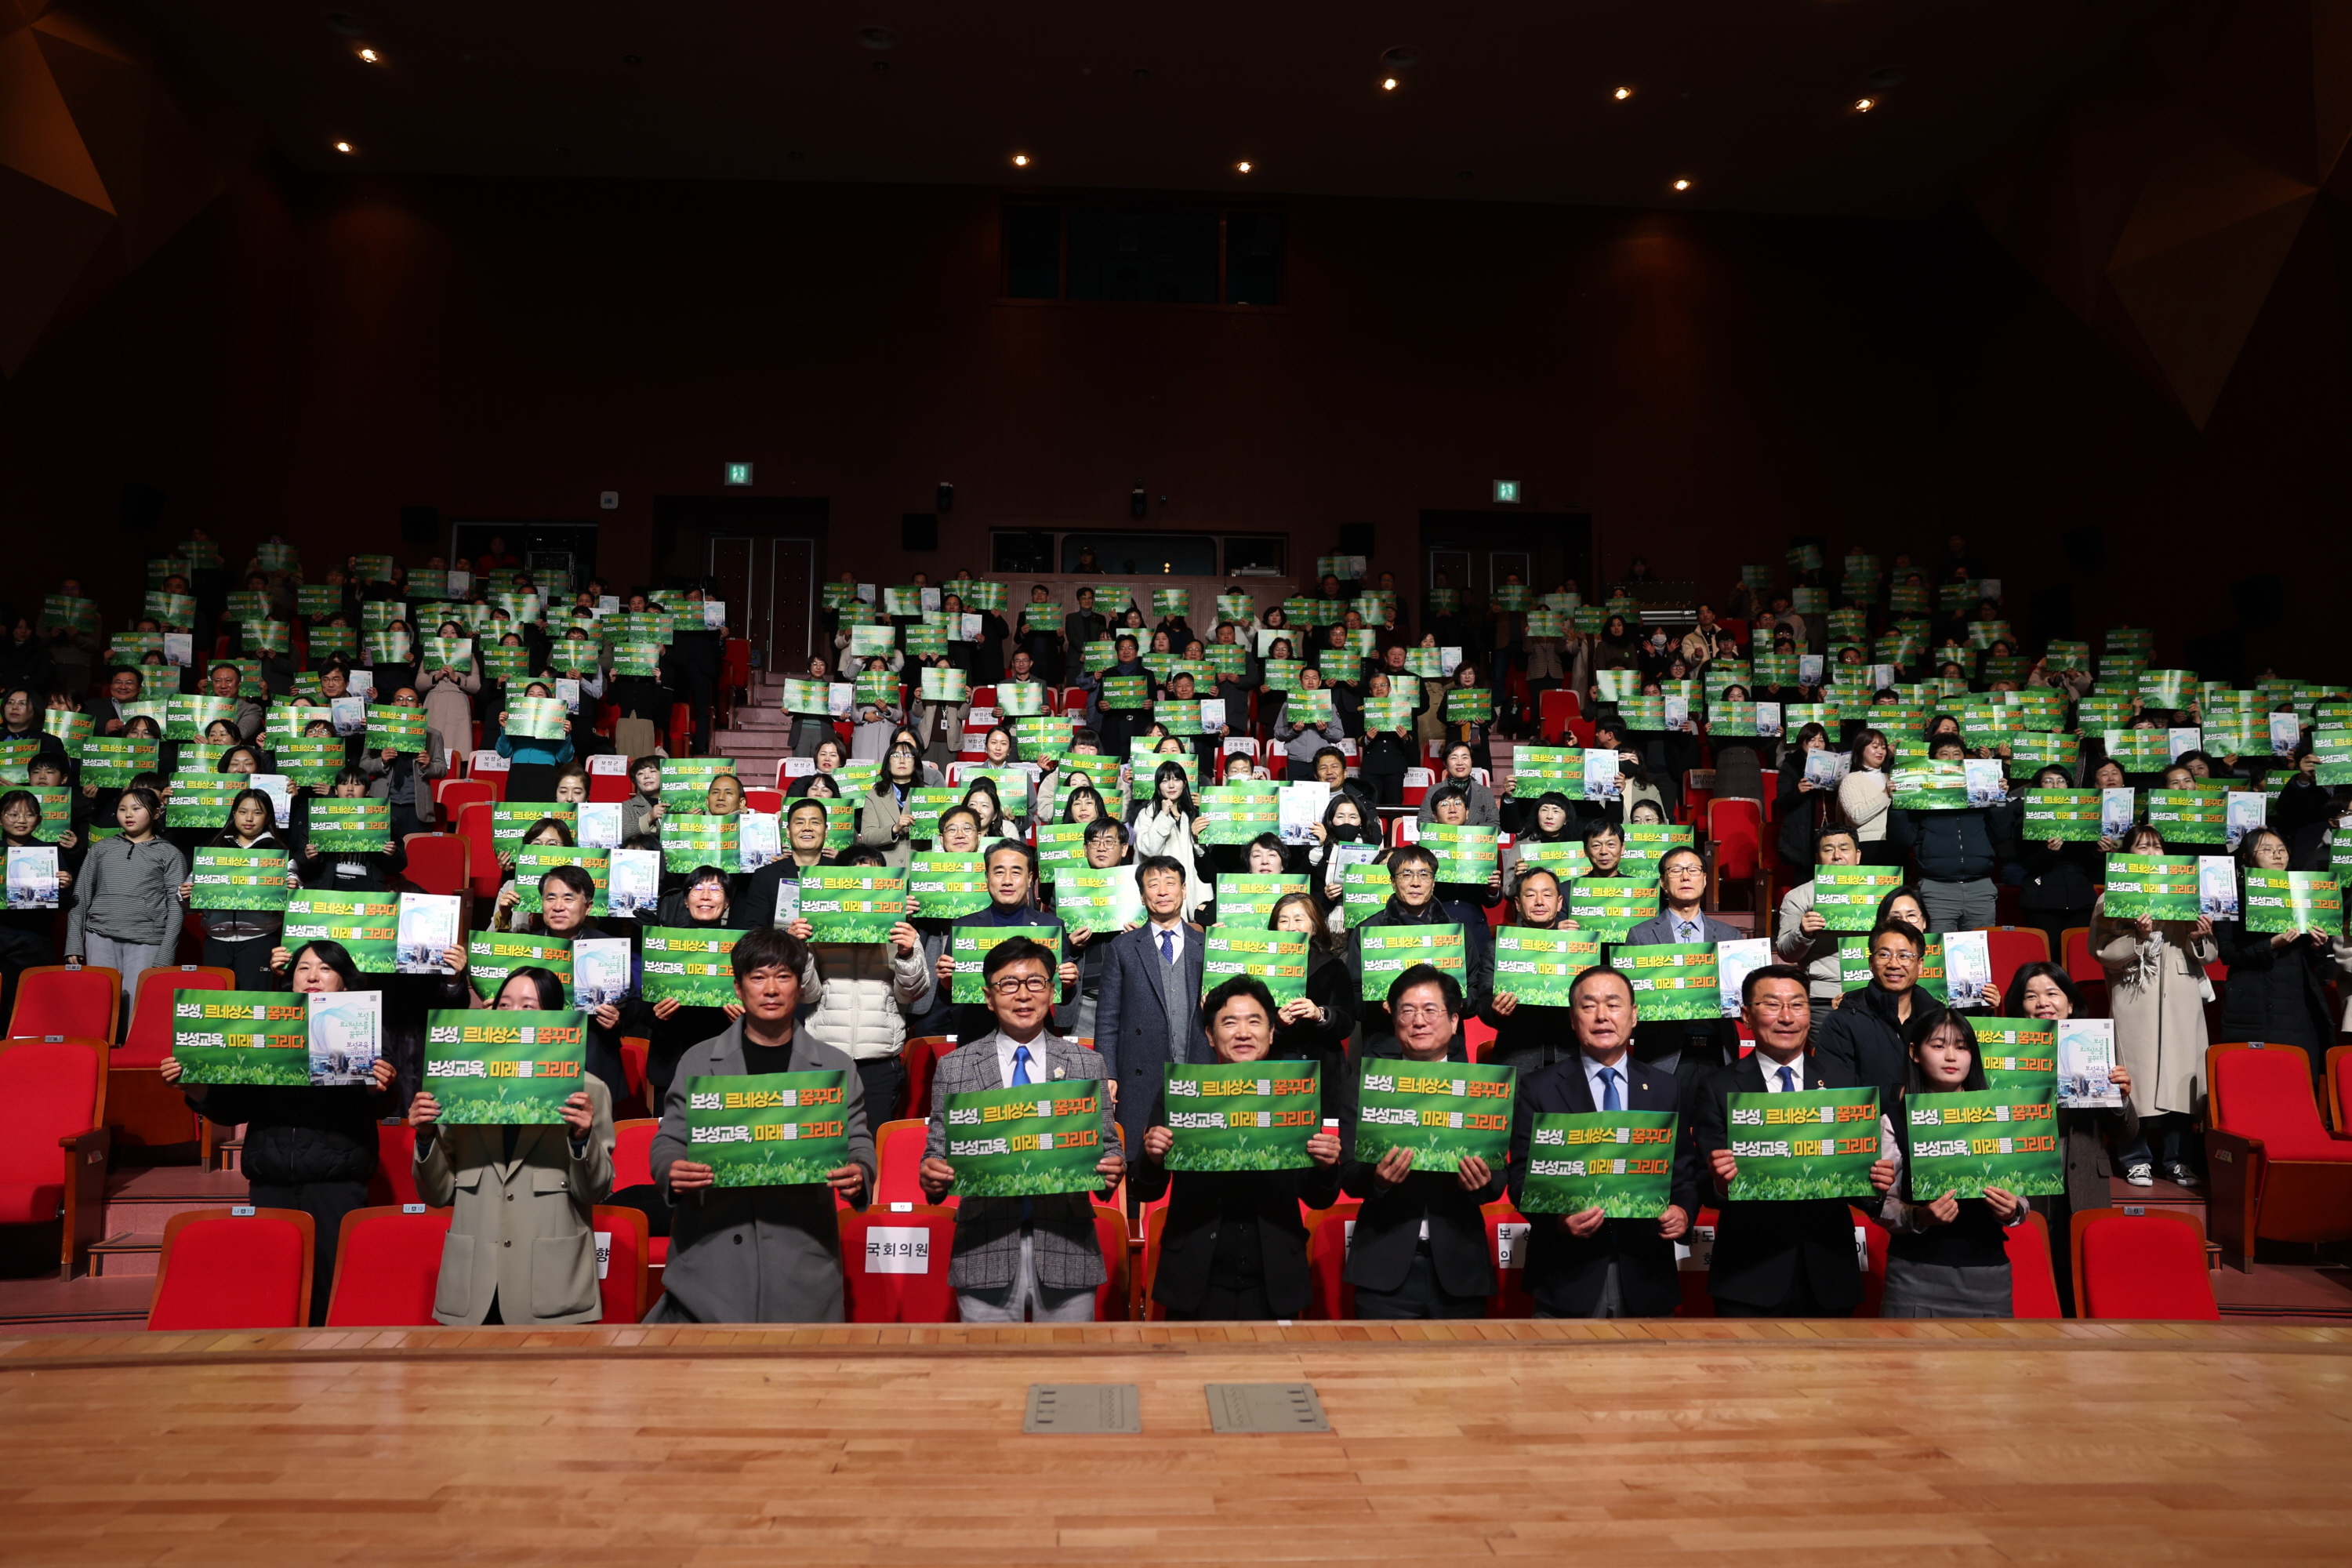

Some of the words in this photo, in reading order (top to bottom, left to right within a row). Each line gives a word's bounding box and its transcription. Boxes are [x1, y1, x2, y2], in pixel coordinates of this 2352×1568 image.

[100, 745, 135, 753] 르네상스를
[82, 759, 112, 768] 보성교육,
[2026, 796, 2043, 804] 보성,
[2043, 796, 2078, 804] 르네상스를
[310, 806, 328, 815] 보성,
[328, 806, 366, 815] 르네상스를
[2025, 811, 2056, 820] 보성교육,
[310, 822, 343, 830] 보성교육,
[343, 822, 365, 830] 미래를
[195, 856, 216, 866] 보성,
[216, 857, 261, 867] 르네상스를
[260, 858, 285, 867] 꿈꾸다
[2108, 862, 2128, 873] 보성,
[2128, 863, 2169, 875] 르네상스를
[2169, 865, 2197, 875] 꿈꾸다
[193, 875, 231, 885] 보성교육,
[232, 876, 258, 885] 미래를
[259, 877, 286, 886] 그리다
[801, 877, 824, 890] 보성,
[824, 878, 874, 890] 르네상스를
[873, 878, 903, 890] 꿈꾸다
[2107, 882, 2143, 893] 보성교육,
[2143, 884, 2169, 894] 미래를
[2170, 884, 2198, 894] 그리다
[1572, 887, 1592, 898] 보성,
[1592, 887, 1633, 898] 르네상스를
[1633, 887, 1658, 898] 꿈꾸다
[288, 901, 313, 914] 보성,
[312, 902, 366, 916] 르네상스를
[365, 904, 397, 916] 꿈꾸다
[801, 900, 843, 913] 보성교육,
[843, 901, 872, 913] 미래를
[873, 902, 903, 913] 그리다
[1570, 906, 1606, 917] 보성교육,
[1607, 907, 1632, 917] 미래를
[1632, 908, 1657, 917] 그리다
[285, 925, 330, 938] 보성교육,
[331, 927, 363, 940] 미래를
[363, 928, 395, 940] 그리다
[176, 1004, 204, 1019] 보성,
[204, 1004, 266, 1020] 르네상스를
[267, 1006, 305, 1021] 꿈꾸다
[176, 1032, 227, 1047] 보성교육,
[228, 1033, 265, 1048] 미래를
[267, 1035, 305, 1048] 그리다
[430, 1026, 461, 1044] 보성,
[463, 1026, 535, 1044] 르네상스를
[537, 1027, 583, 1044] 꿈꾸다
[426, 1060, 488, 1078] 보성교육,
[489, 1061, 533, 1078] 미래를
[535, 1061, 580, 1078] 그리다
[1169, 1079, 1200, 1098] 보성,
[1202, 1079, 1271, 1096] 르네상스를
[1273, 1078, 1316, 1095] 꿈꾸다
[1363, 1074, 1396, 1093] 보성,
[1397, 1076, 1466, 1096] 르네상스를
[1468, 1080, 1511, 1098] 꿈꾸다
[691, 1093, 724, 1110] 보성,
[725, 1090, 797, 1109] 르네상스를
[799, 1087, 843, 1106] 꿈꾸다
[949, 1108, 982, 1124] 보성,
[983, 1100, 1051, 1123] 르네상스를
[1054, 1097, 1097, 1116] 꿈꾸다
[1361, 1107, 1420, 1127] 보성교육,
[1422, 1110, 1464, 1129] 미래를
[1465, 1113, 1508, 1131] 그리다
[1732, 1109, 1764, 1126] 보성,
[1766, 1106, 1834, 1124] 르네상스를
[1836, 1104, 1877, 1122] 꿈꾸다
[1911, 1109, 1942, 1125] 보성,
[1944, 1105, 2009, 1123] 르네상스를
[2012, 1104, 2053, 1121] 꿈꾸다
[1168, 1112, 1228, 1129] 보성교육,
[1229, 1111, 1271, 1127] 미래를
[1273, 1110, 1316, 1127] 그리다
[691, 1125, 753, 1143] 보성교육,
[754, 1123, 797, 1141] 미래를
[800, 1120, 844, 1139] 그리다
[1534, 1129, 1566, 1146] 보성,
[1566, 1127, 1630, 1145] 르네상스를
[1632, 1128, 1672, 1144] 꿈꾸다
[950, 1138, 1011, 1156] 보성교육,
[1011, 1133, 1053, 1152] 미래를
[1055, 1130, 1098, 1149] 그리다
[1730, 1141, 1792, 1157] 보성교육,
[1794, 1139, 1835, 1156] 미래를
[1837, 1137, 1878, 1154] 그리다
[1913, 1140, 1971, 1157] 보성교육,
[1973, 1138, 2013, 1155] 미래를
[2015, 1135, 2056, 1152] 그리다
[1530, 1160, 1587, 1176] 보성교육,
[1588, 1159, 1626, 1174] 미래를
[1628, 1160, 1669, 1174] 그리다
[866, 1240, 928, 1258] 국회의원
